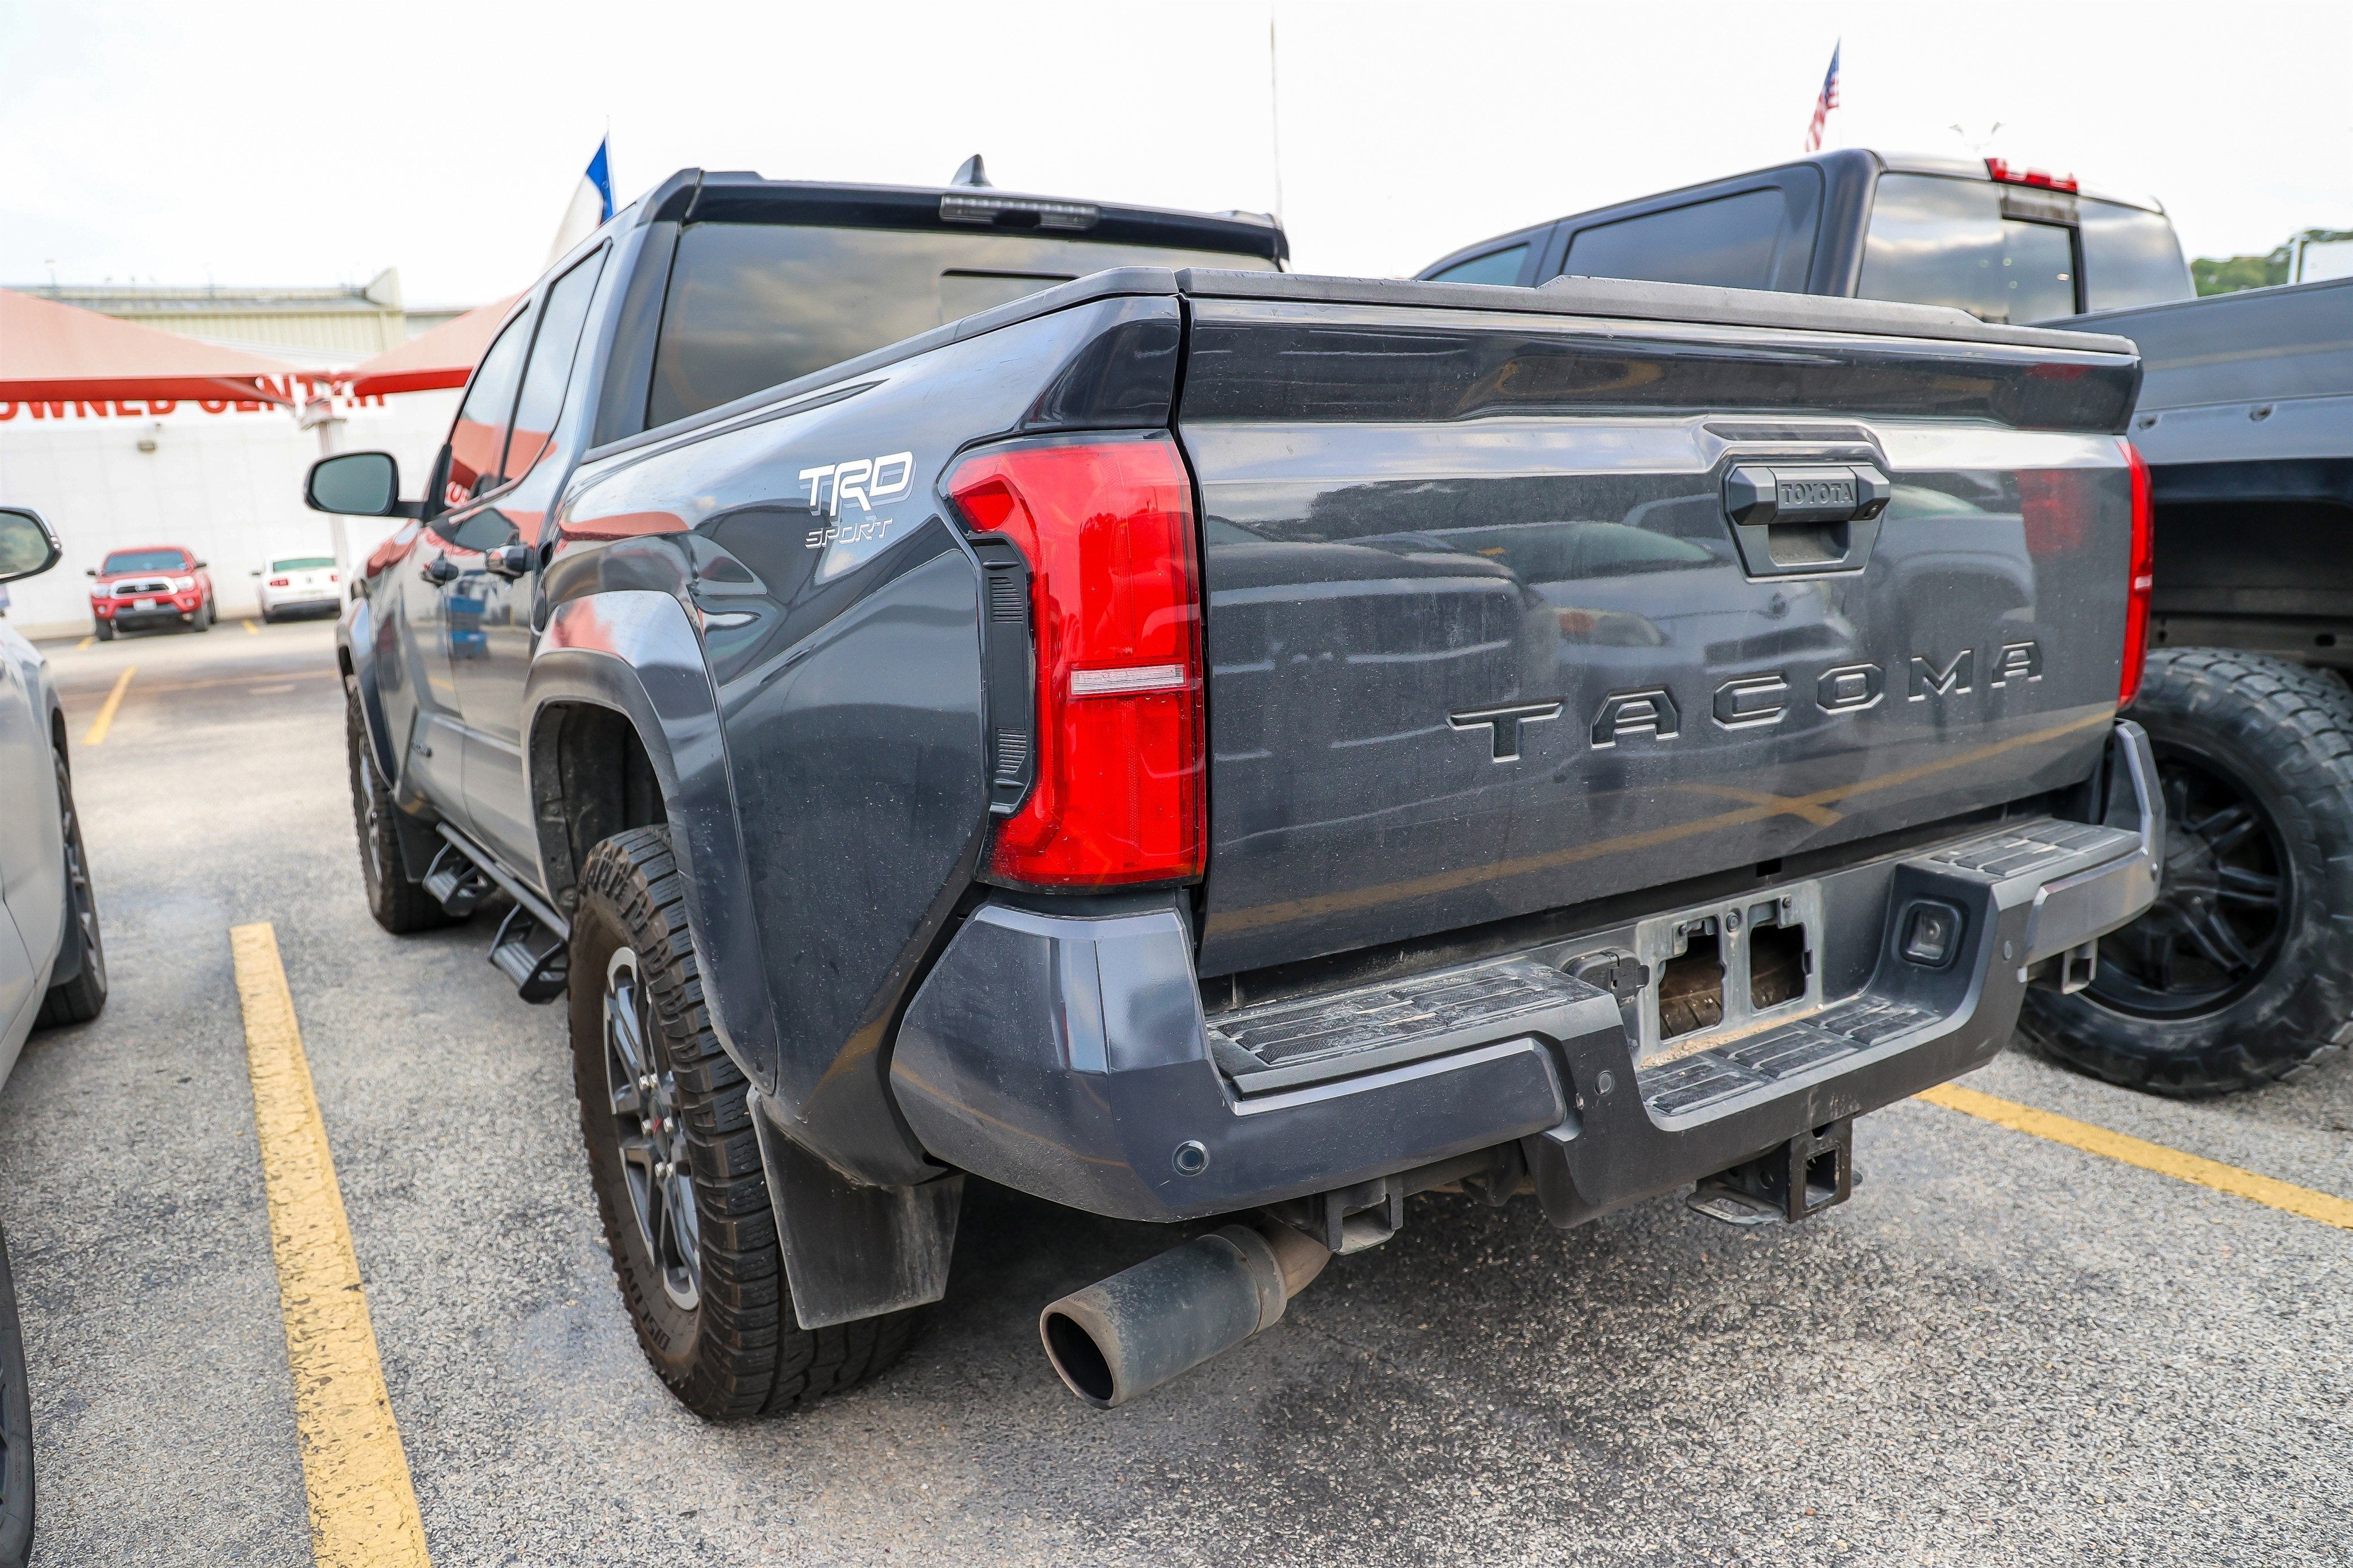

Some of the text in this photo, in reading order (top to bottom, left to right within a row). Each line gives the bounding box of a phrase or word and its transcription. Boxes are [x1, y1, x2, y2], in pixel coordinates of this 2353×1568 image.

[798, 450, 914, 517] TRD
[1781, 482, 1855, 505] TOYOTA
[805, 517, 894, 549] SPORT
[1445, 640, 2044, 763] TACOMA
